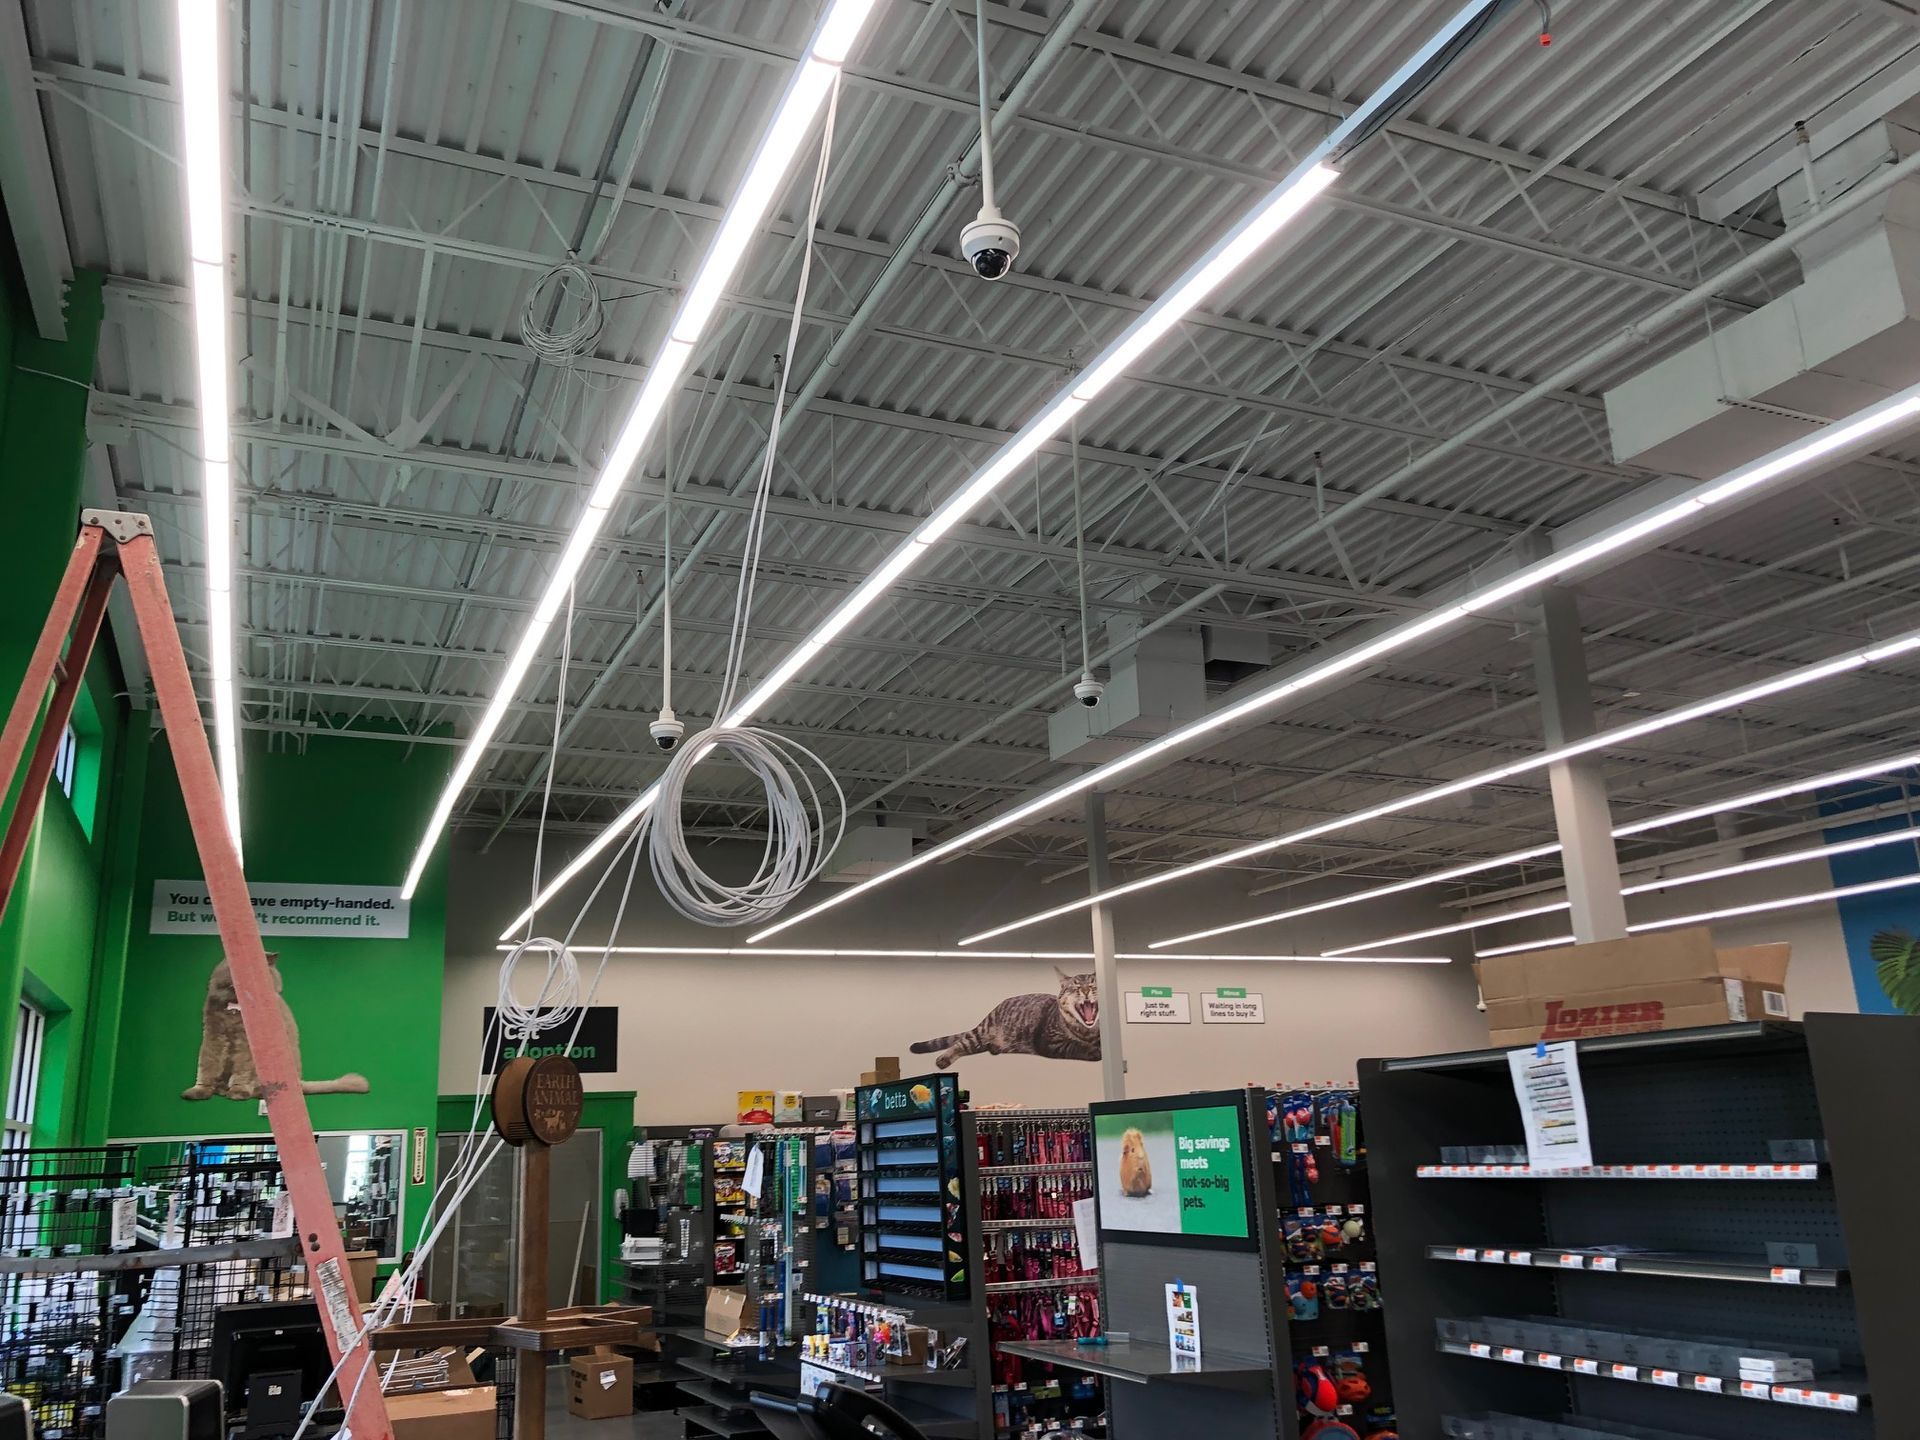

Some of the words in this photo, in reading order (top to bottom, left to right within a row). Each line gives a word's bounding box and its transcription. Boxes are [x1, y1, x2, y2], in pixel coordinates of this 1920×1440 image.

[169, 893, 198, 905] You
[280, 897, 395, 910] empty-handed.
[167, 911, 196, 922] But
[272, 914, 361, 926] recommend
[365, 914, 380, 926] it.
[1140, 1009, 1157, 1018] right
[1158, 1009, 1177, 1017] stuff.
[1208, 1002, 1234, 1010] Waiting
[1236, 1010, 1248, 1018] buy
[537, 1074, 575, 1089] EARTH
[534, 1090, 579, 1105] ANIMAL
[884, 1092, 907, 1109] betta
[1178, 1136, 1193, 1153] Big
[1195, 1135, 1230, 1152] savings
[1180, 1156, 1208, 1169] meets
[1182, 1174, 1230, 1192] not-so-big
[1183, 1195, 1206, 1211] pets.
